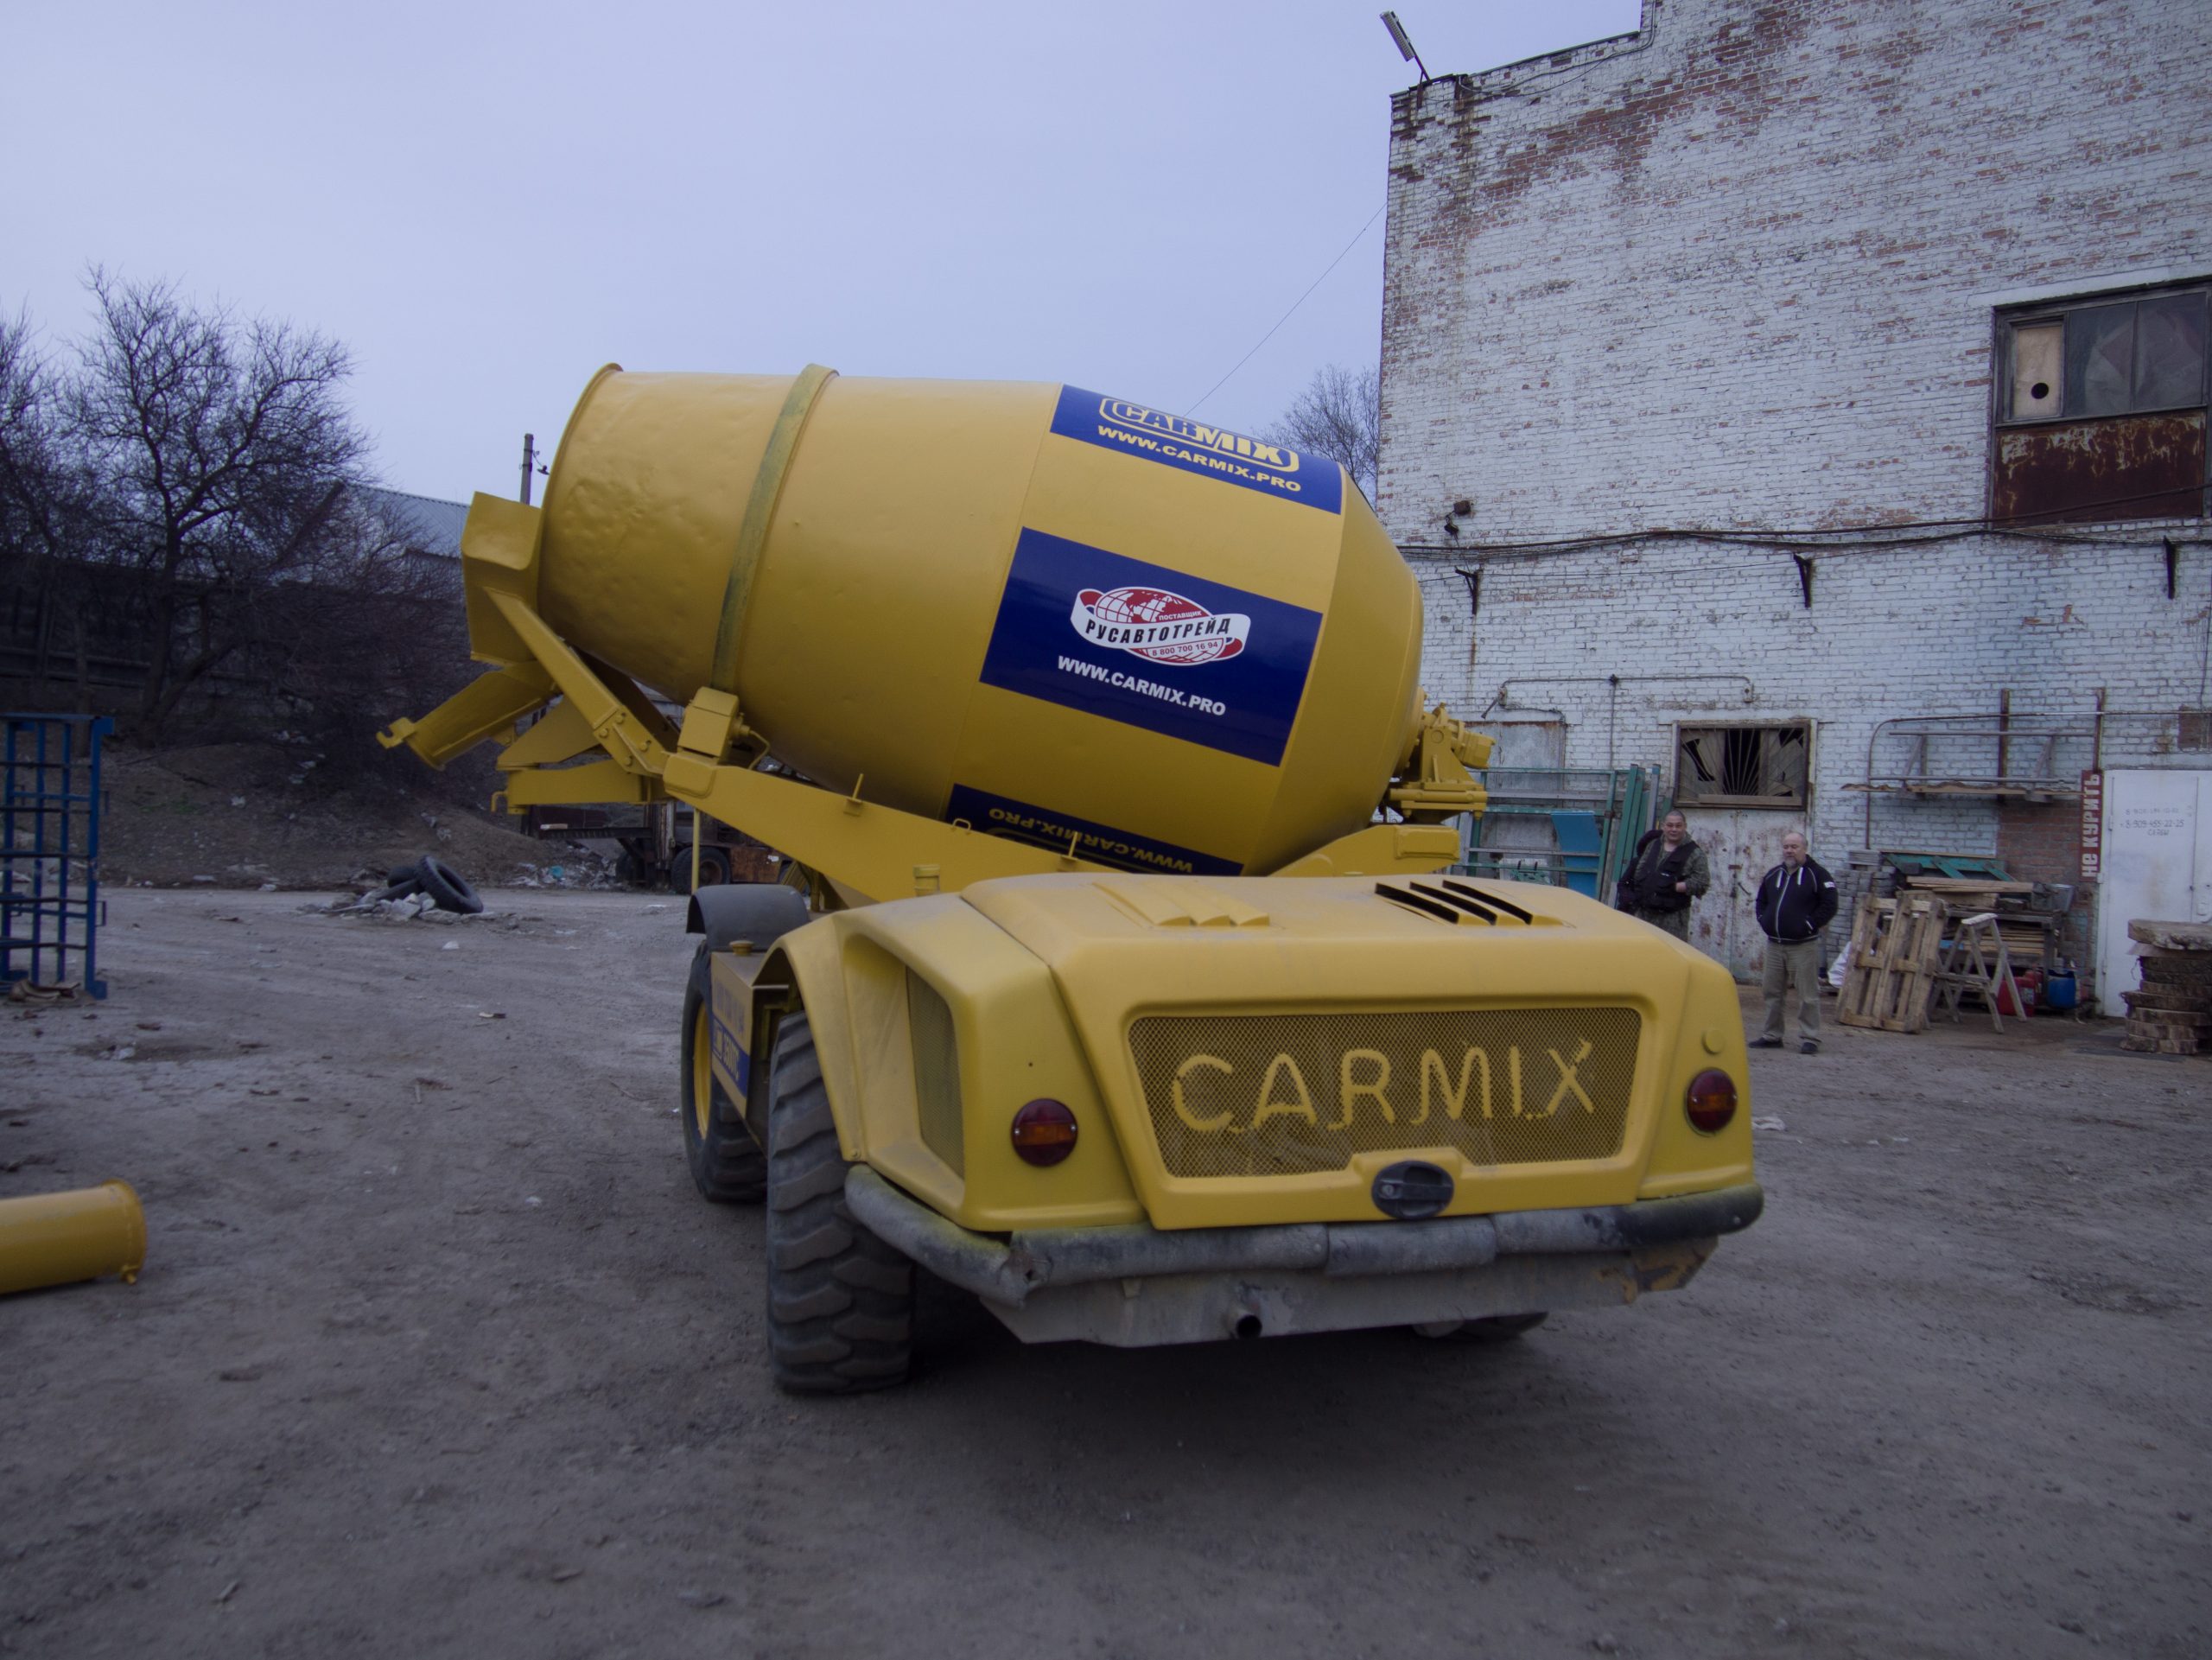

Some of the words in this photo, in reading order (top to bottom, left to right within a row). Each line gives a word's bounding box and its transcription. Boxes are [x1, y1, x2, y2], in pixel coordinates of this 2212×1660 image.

[1097, 425, 1301, 492] WWW.CARMIX.PRO
[1112, 400, 1284, 465] CARMIX
[1085, 617, 1231, 644] РУСАВТОТРЕЙД
[1159, 610, 1202, 620] ПОСТАВЩИК
[1178, 645, 1193, 653] 700
[1058, 655, 1226, 716] WWW.CARMIX.PRO
[2082, 773, 2100, 848] КУРИТЬ
[1173, 1039, 1596, 1135] CARMIX
